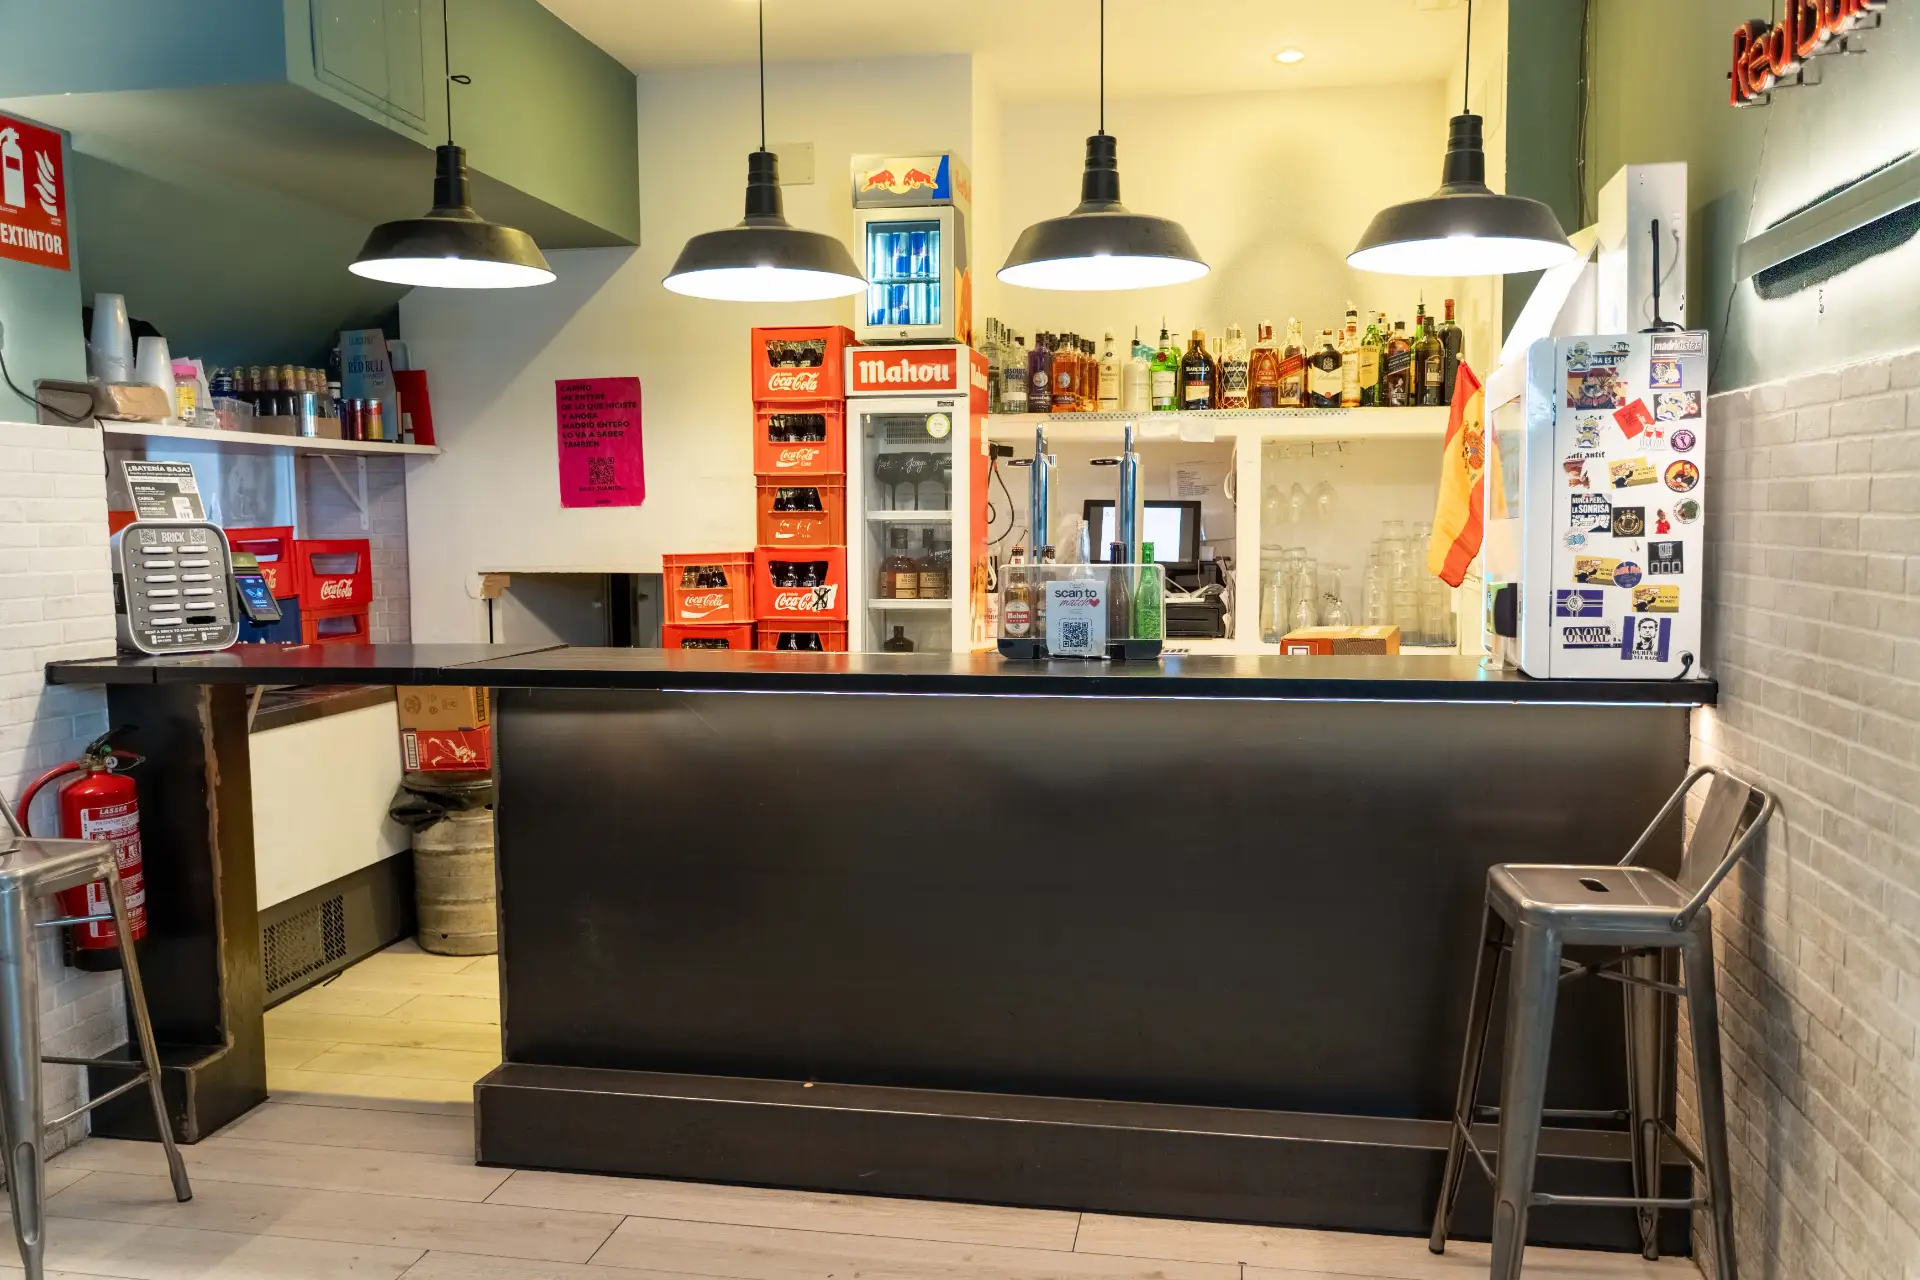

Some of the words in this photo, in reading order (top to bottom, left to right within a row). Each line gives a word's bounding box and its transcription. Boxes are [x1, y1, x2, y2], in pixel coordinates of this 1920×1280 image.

[0, 222, 64, 256] EXTINTOR
[1653, 338, 1702, 351] madridistas
[348, 361, 364, 373] RED
[365, 360, 384, 372] BULL
[858, 358, 951, 385] Mahou
[767, 372, 820, 391] Coca-Cola
[587, 402, 603, 410] QUE
[605, 401, 637, 409] HICISTE
[569, 412, 598, 420] AHORA
[128, 464, 165, 473] ¿BATERÍA
[1578, 504, 1610, 513] SONRISA
[161, 531, 186, 543] BRICK
[320, 578, 353, 600] Coca-Cola
[1054, 589, 1083, 599] scan
[1084, 588, 1098, 598] to
[684, 593, 724, 607] Coca-Cola
[774, 592, 813, 611] Coca-Co
[100, 805, 127, 815] LASSER
[127, 907, 143, 917] SSER
